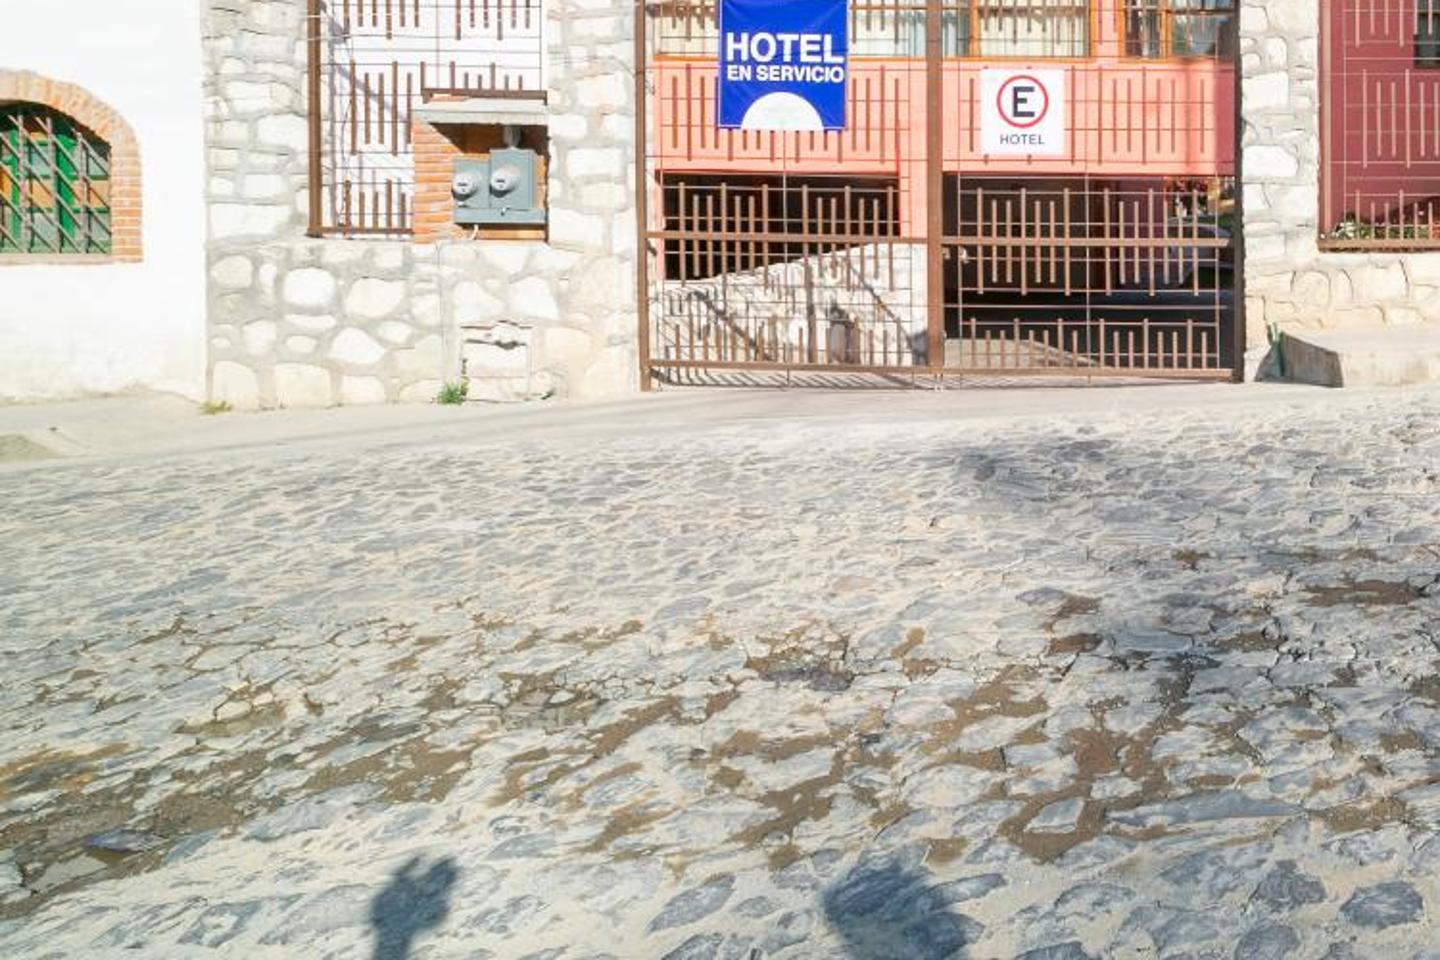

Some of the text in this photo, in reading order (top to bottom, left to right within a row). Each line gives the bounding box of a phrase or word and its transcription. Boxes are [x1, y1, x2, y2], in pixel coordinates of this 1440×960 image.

[726, 31, 845, 63] HOTEL
[726, 64, 845, 83] EN SERVICIO
[1012, 86, 1036, 118] E
[999, 134, 1045, 145] HOTEL
